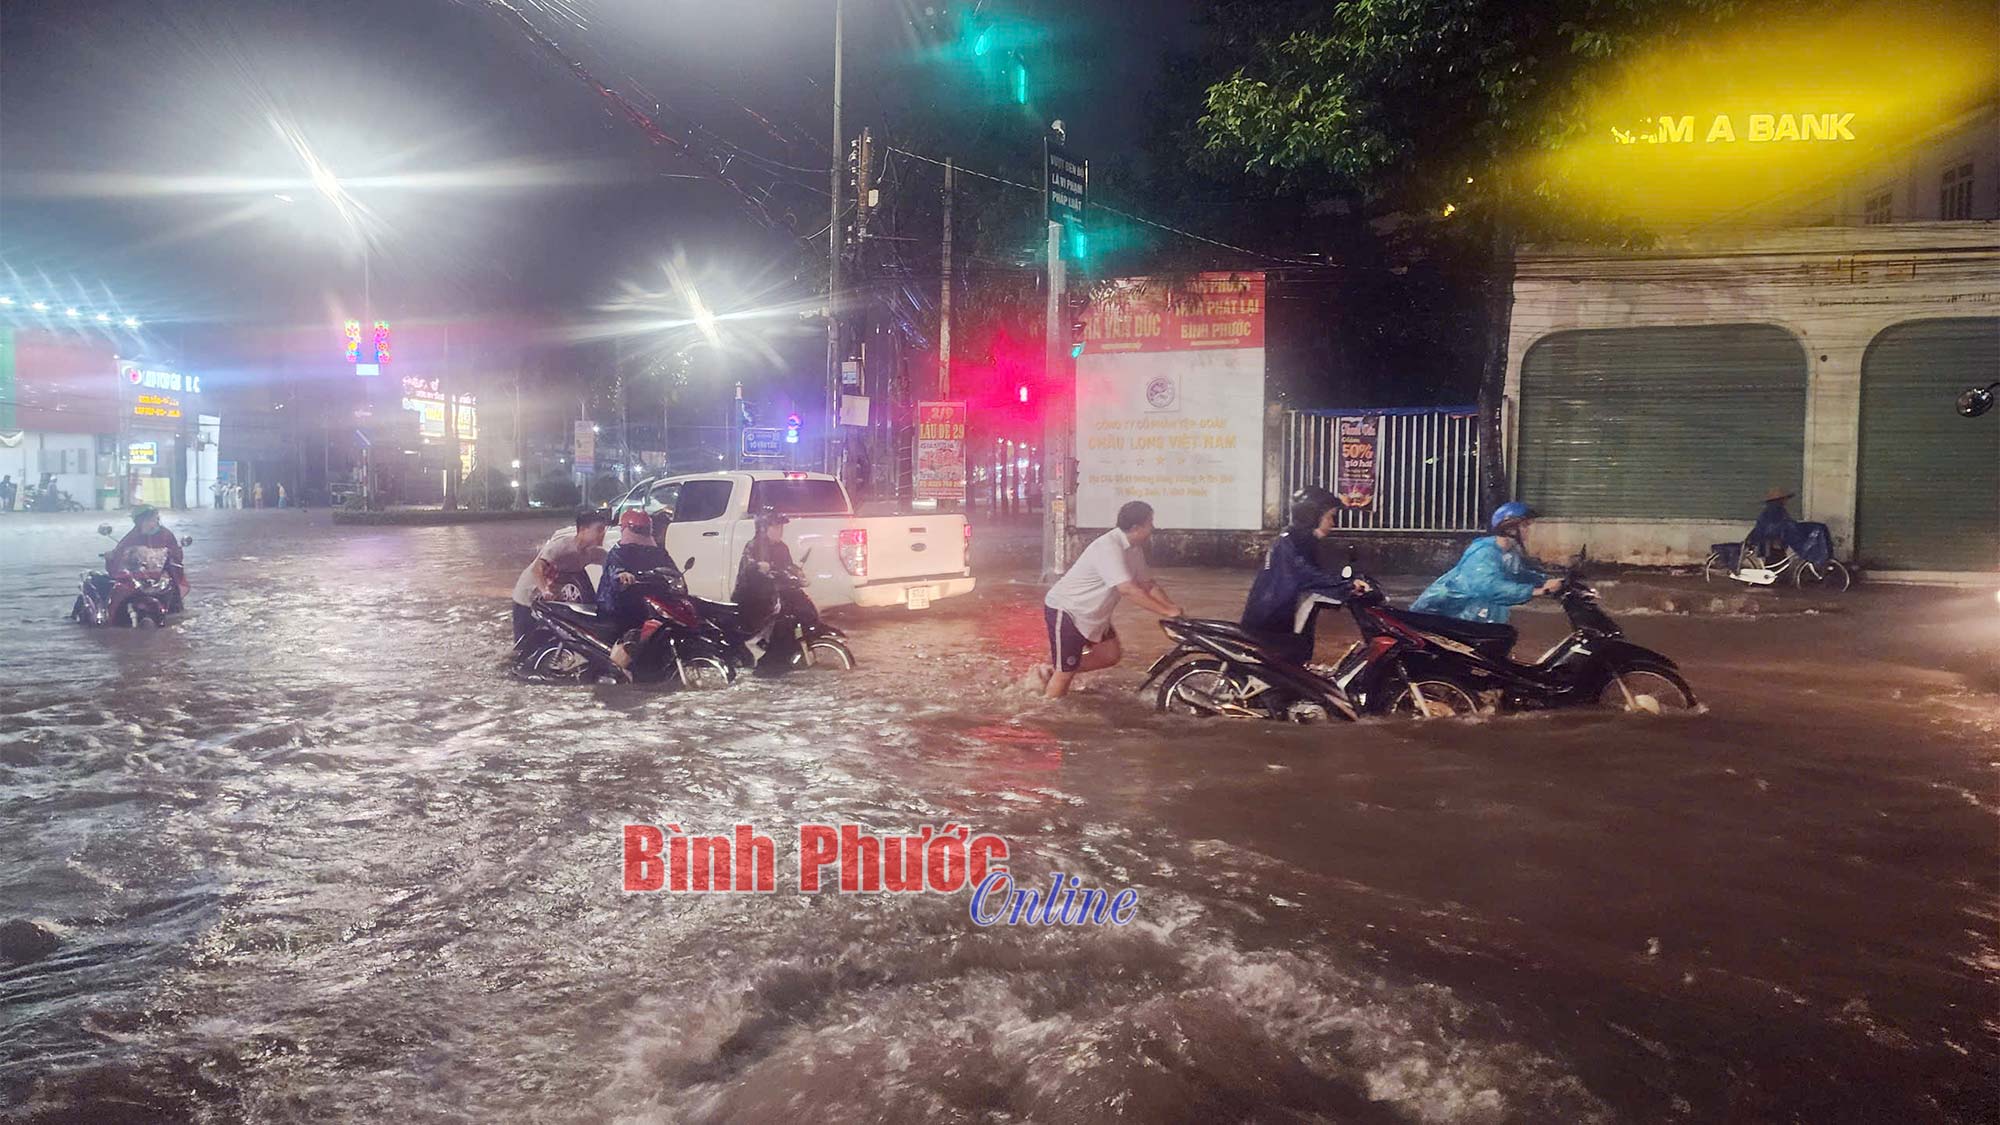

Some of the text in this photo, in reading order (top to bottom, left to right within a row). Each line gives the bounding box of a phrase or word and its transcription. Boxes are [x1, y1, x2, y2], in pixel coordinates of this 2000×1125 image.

[1748, 113, 1855, 142] BANK
[931, 407, 954, 420] 2/9
[953, 423, 965, 439] 29
[1203, 433, 1236, 449] NAM
[1342, 443, 1373, 459] 50%
